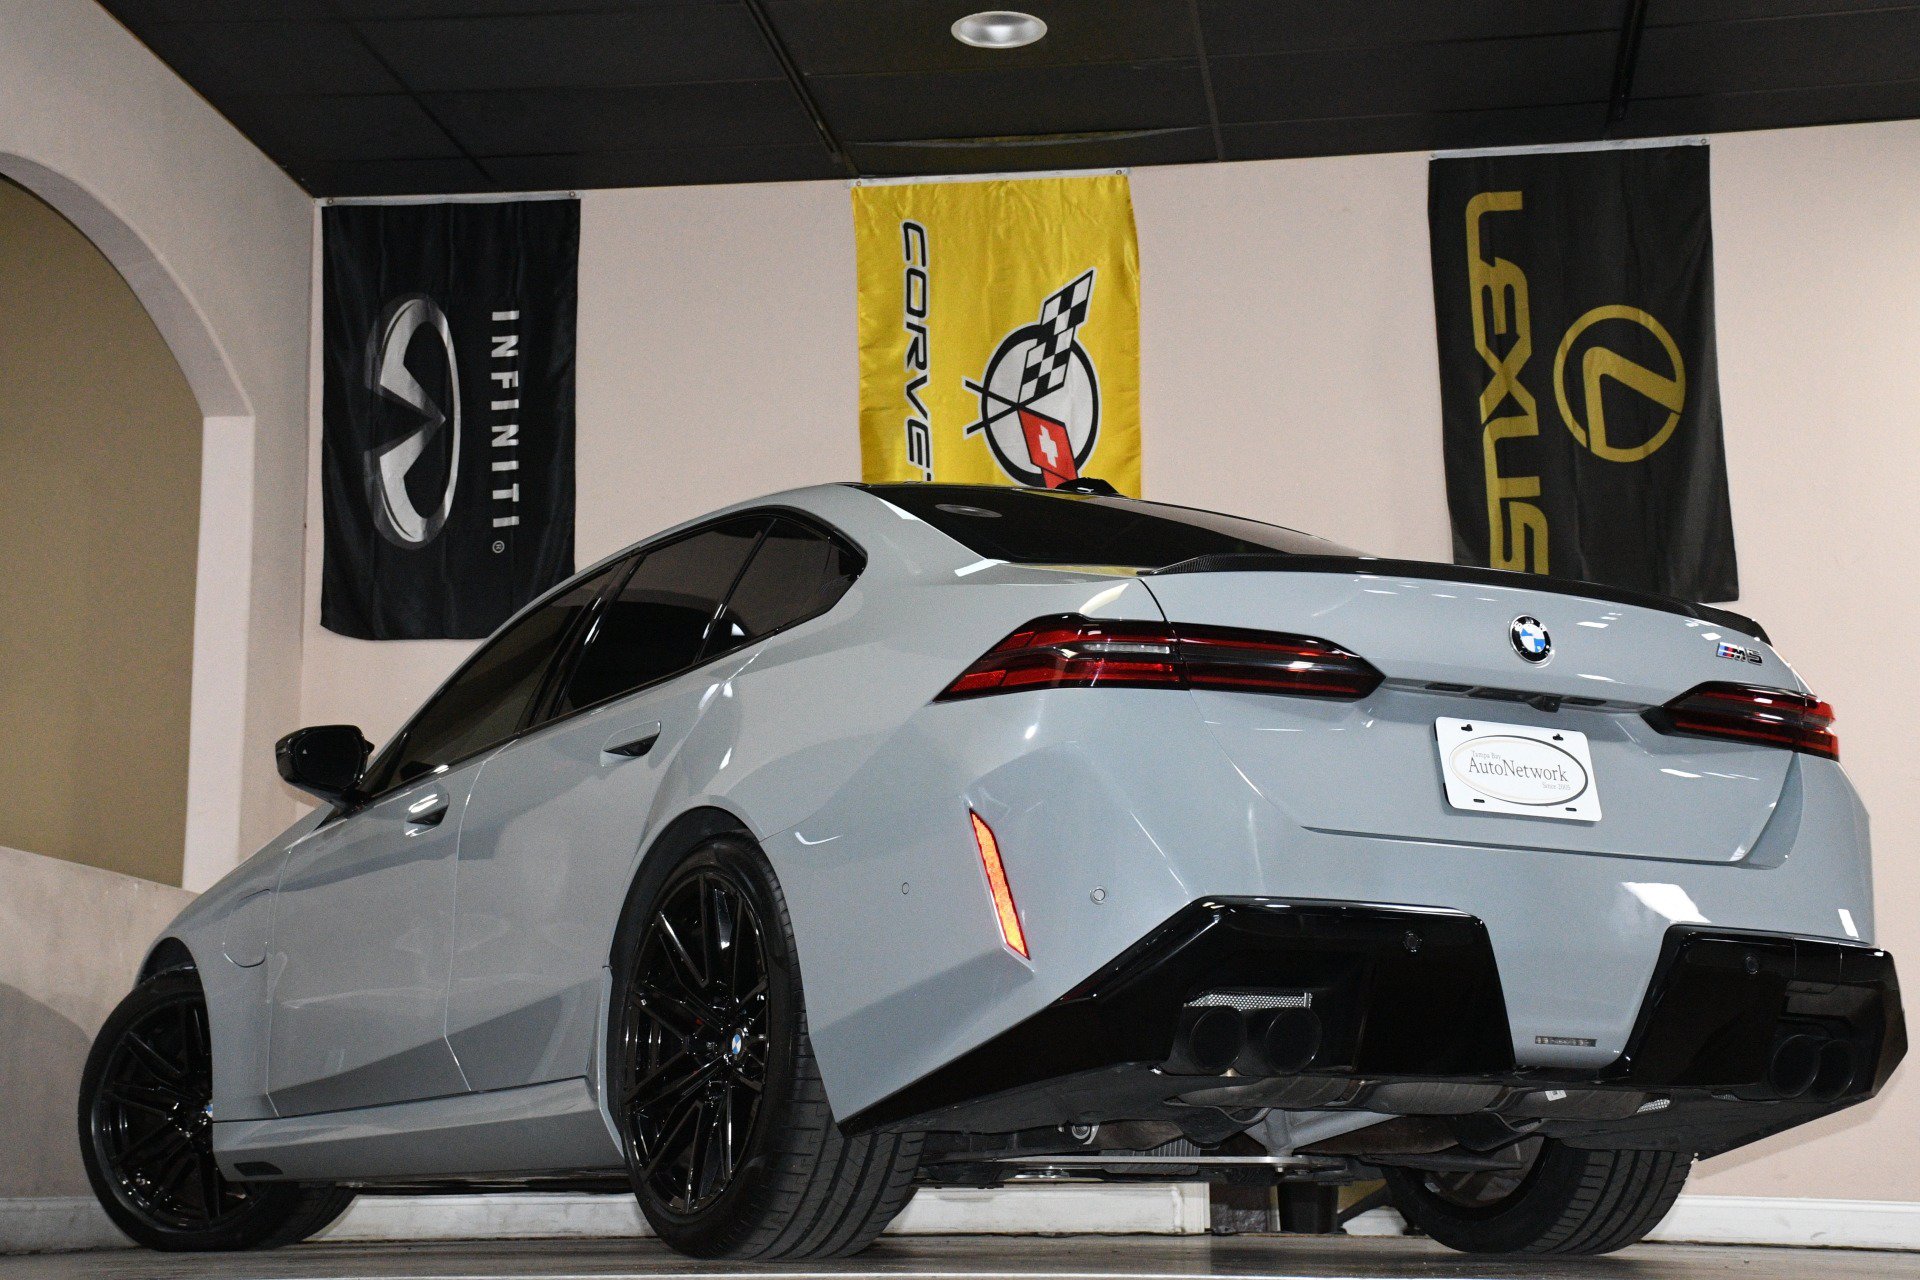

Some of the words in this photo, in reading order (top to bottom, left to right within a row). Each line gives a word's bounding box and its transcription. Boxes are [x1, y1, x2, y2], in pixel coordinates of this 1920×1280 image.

[491, 309, 520, 528] INFINITI
[903, 221, 932, 482] CORVE
[1465, 191, 1549, 575] LEXUS
[1469, 757, 1569, 782] AutoNetwork
